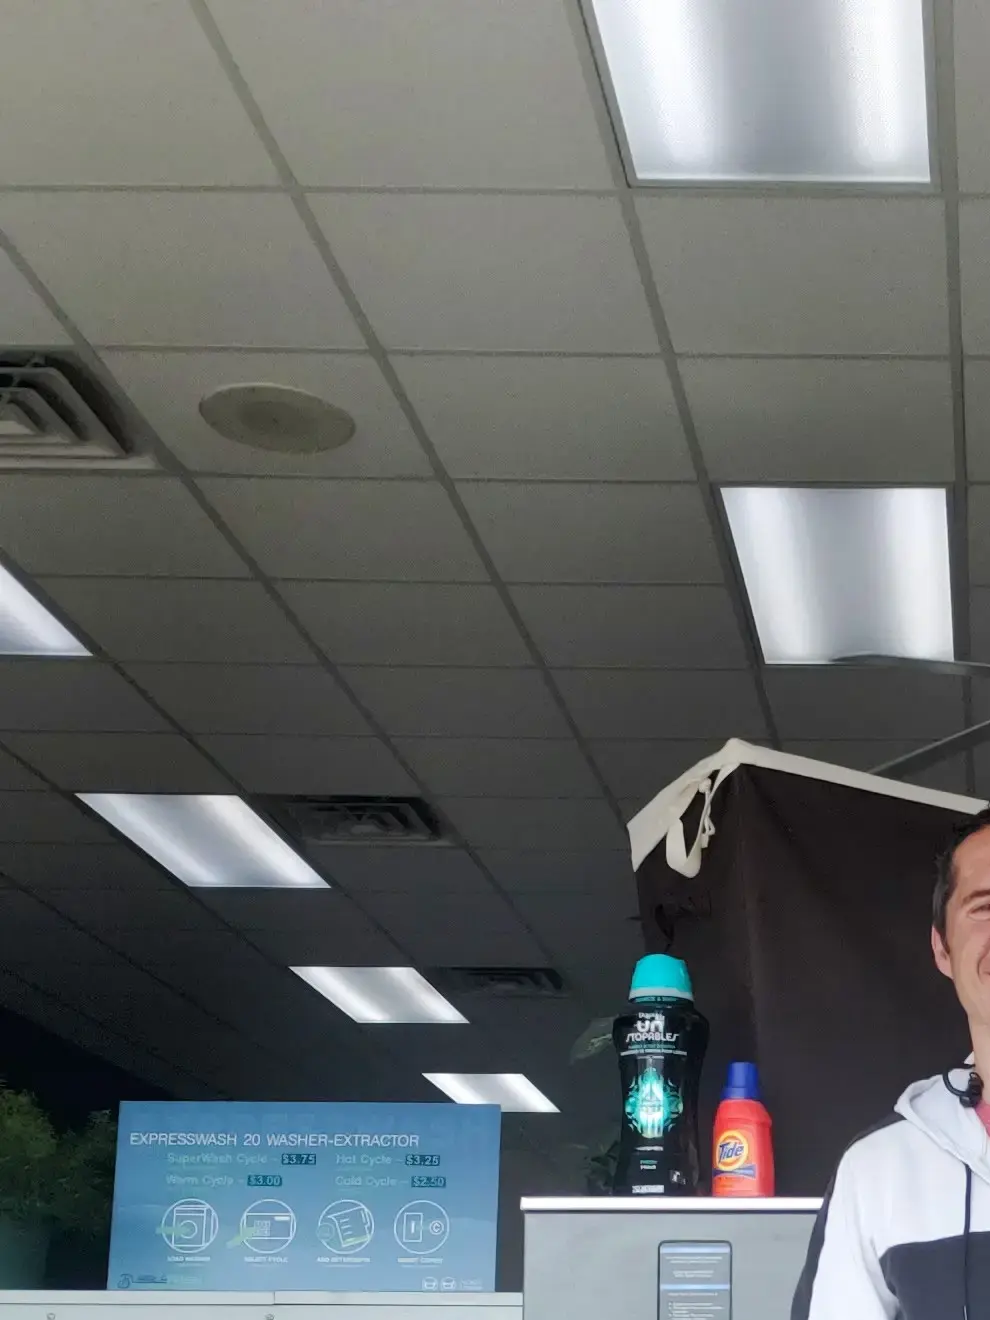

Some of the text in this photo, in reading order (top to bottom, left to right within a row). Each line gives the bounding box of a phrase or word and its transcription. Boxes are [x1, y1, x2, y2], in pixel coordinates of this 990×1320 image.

[625, 1032, 680, 1043] STOPABLES
[129, 1132, 420, 1148] EXPRESSWASH 20 WASHER-EXTRACTOR
[718, 1142, 745, 1164] Tide
[236, 1153, 267, 1166] Cycle
[282, 1154, 316, 1165] $3.75
[335, 1154, 439, 1166] Hot Cycle $3.25
[202, 1175, 234, 1187] Cycle
[248, 1175, 281, 1186] $3.00
[365, 1176, 397, 1188] Cycle
[412, 1176, 445, 1187] $2.50
